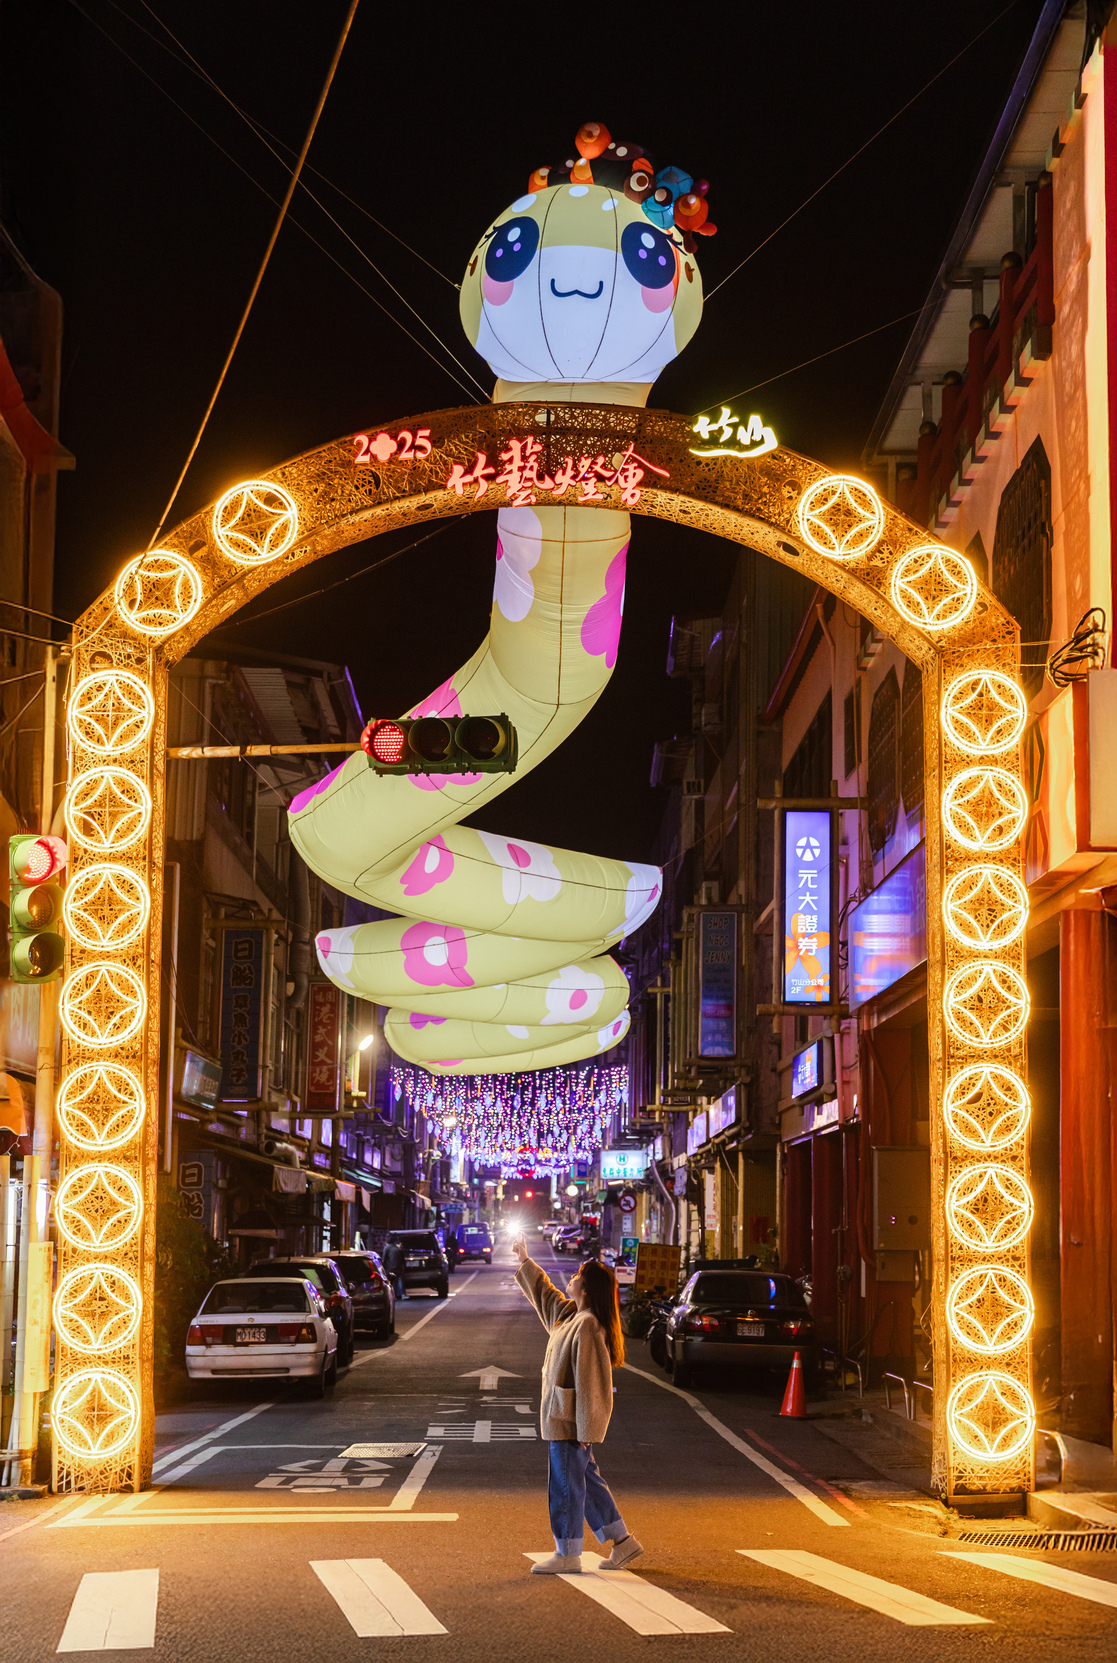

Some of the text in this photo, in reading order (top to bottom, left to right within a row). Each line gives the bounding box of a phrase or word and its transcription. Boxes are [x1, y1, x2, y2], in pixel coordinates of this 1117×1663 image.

[689, 406, 778, 457] 竹山
[447, 433, 670, 507] 竹藝燈會
[708, 916, 729, 929] SHOP
[798, 869, 818, 956] 元大證券
[230, 937, 255, 988] 日船
[705, 950, 732, 964] JENNY
[791, 978, 824, 986] 竹山分公司
[791, 986, 802, 994] 2F
[313, 1003, 335, 1085] 港式叉燒
